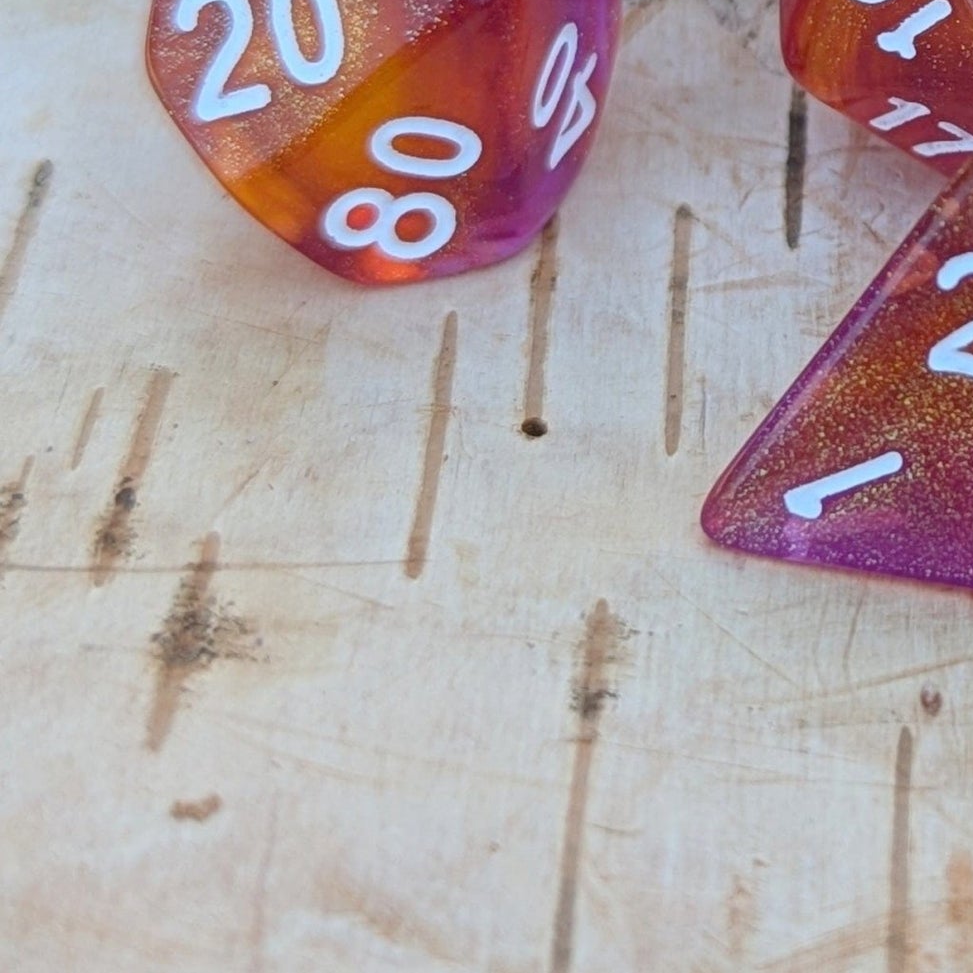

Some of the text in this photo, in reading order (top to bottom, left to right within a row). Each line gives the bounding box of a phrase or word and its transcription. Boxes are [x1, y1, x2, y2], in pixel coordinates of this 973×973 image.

[533, 22, 598, 170] 40
[323, 117, 482, 261] 80
[784, 452, 902, 519] 1
